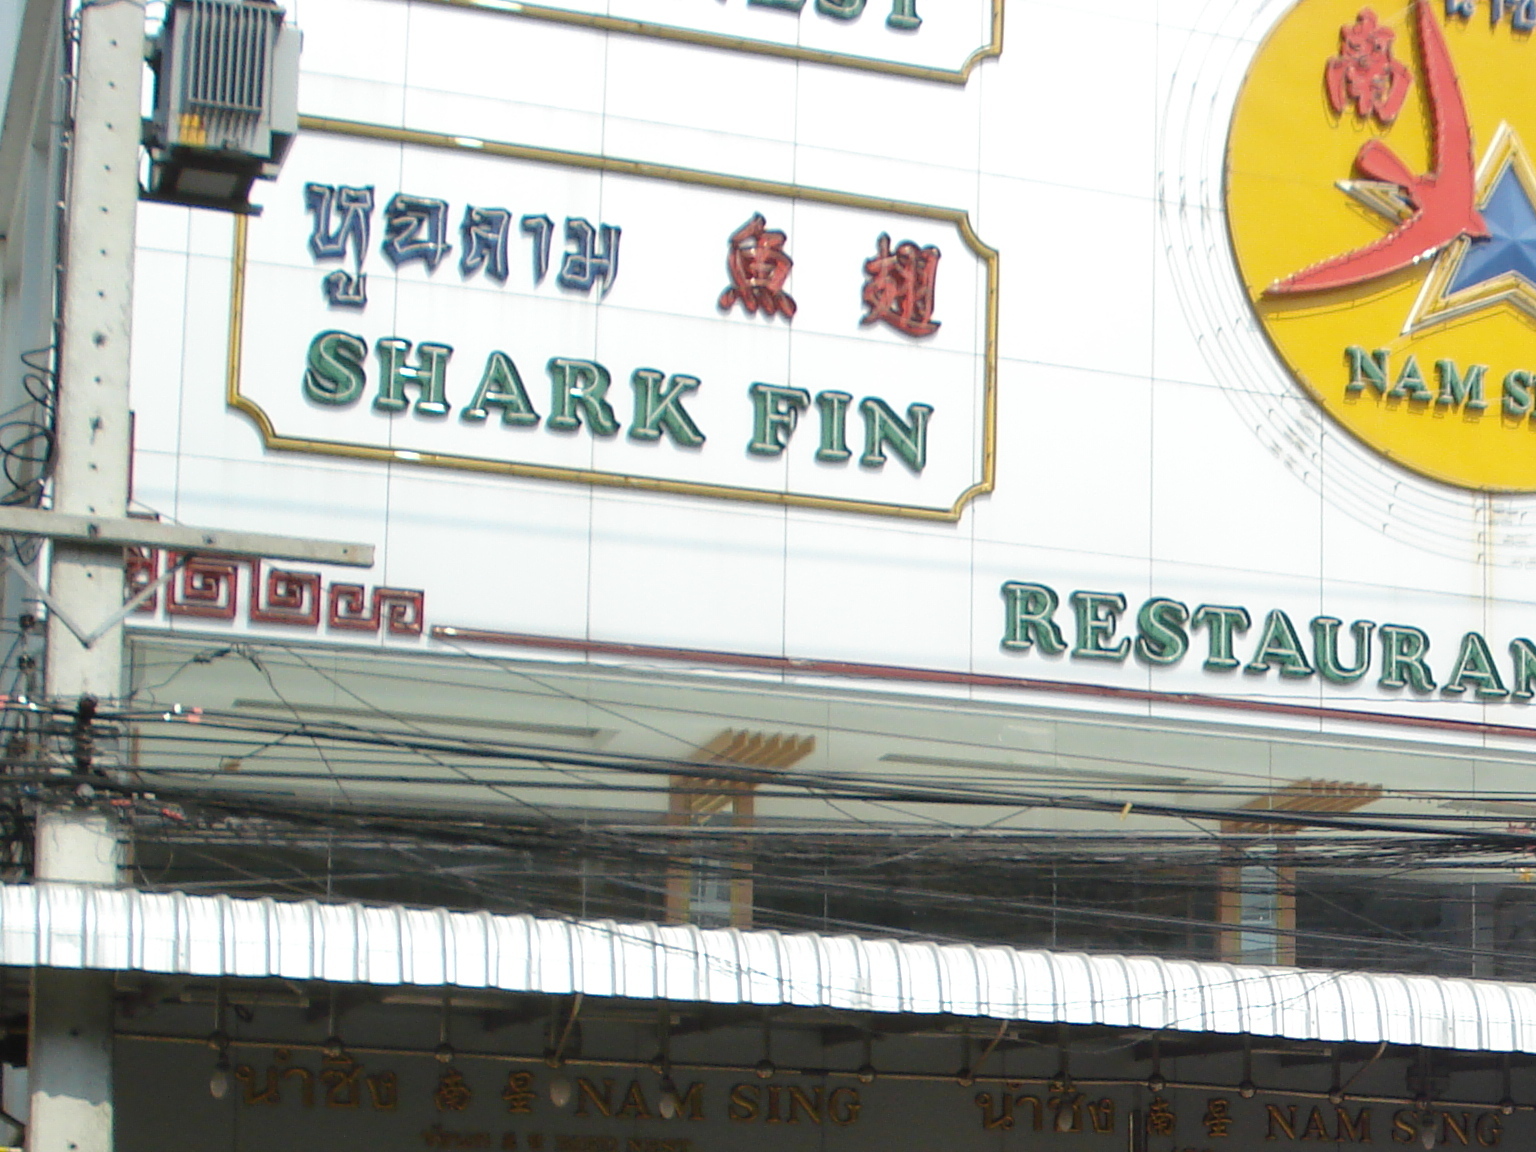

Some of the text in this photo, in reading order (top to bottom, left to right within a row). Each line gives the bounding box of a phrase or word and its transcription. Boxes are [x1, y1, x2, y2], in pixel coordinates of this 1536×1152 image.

[302, 330, 935, 472] SHARK FIN
[1343, 346, 1490, 414] NAM
[576, 1075, 863, 1127] NAM SING
[1265, 1103, 1374, 1145] NAM
